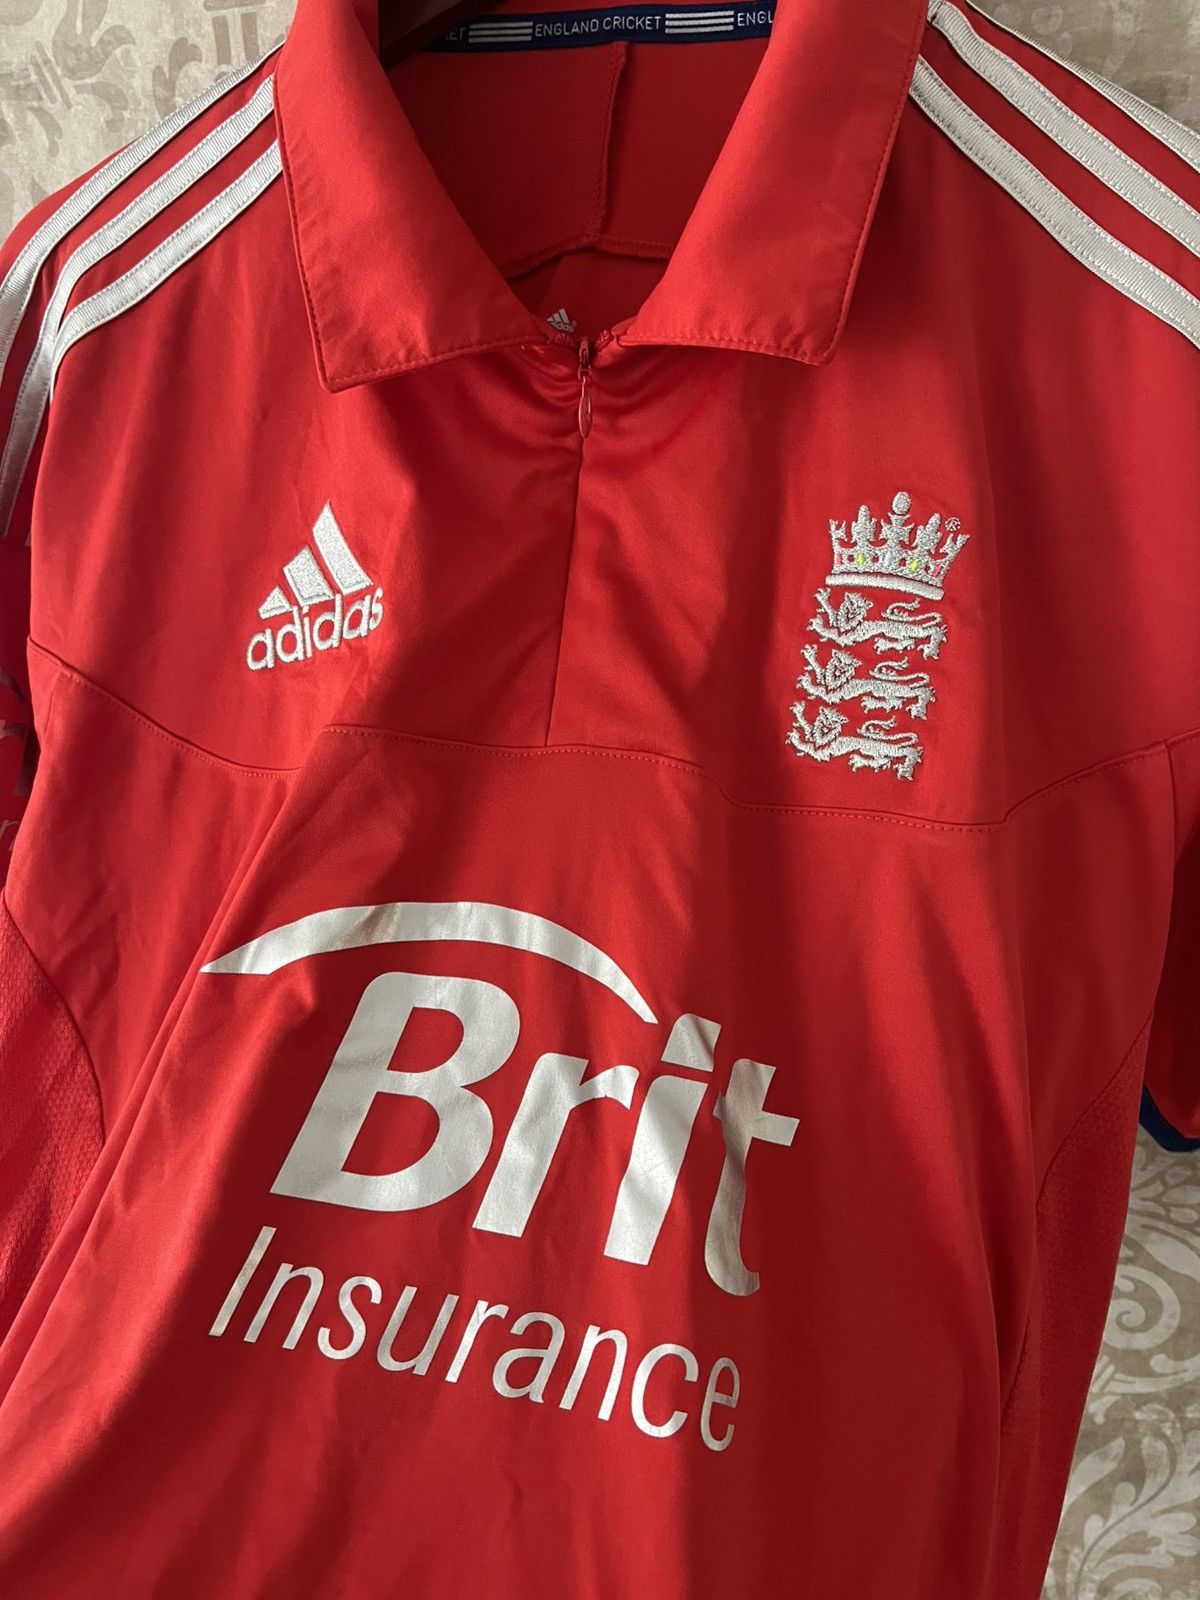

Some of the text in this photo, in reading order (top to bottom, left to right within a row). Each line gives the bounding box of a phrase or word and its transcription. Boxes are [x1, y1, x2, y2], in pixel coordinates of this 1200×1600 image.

[534, 16, 662, 37] ENGLAND CRICKET
[246, 587, 384, 671] adidas
[269, 971, 800, 1297] Brit
[208, 1226, 741, 1452] Insurance
